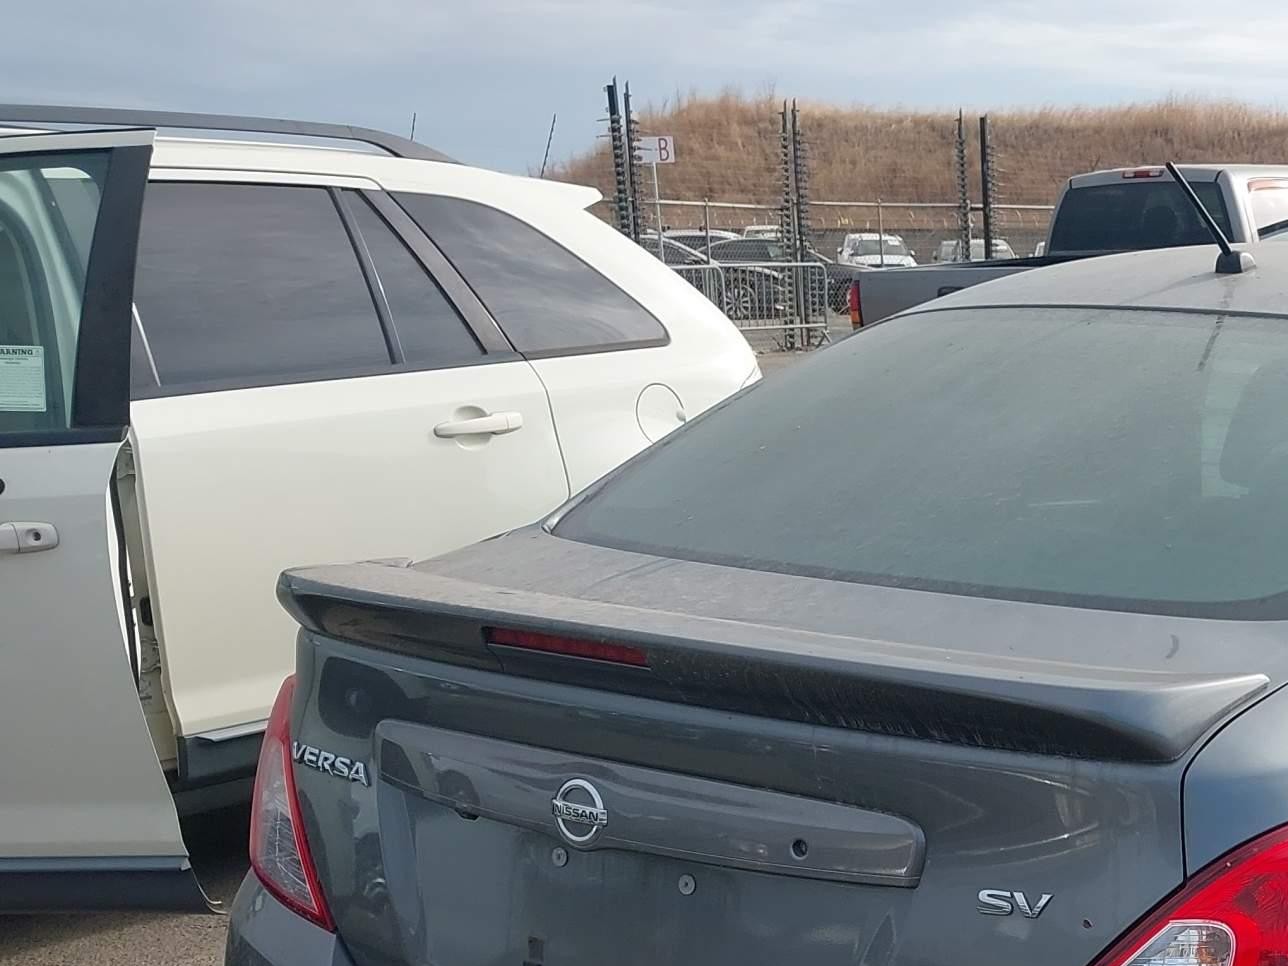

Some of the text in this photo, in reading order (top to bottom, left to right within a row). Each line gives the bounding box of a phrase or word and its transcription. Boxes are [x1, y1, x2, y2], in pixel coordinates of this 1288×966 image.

[658, 137, 670, 162] B
[292, 741, 369, 787] VERSA
[552, 801, 599, 822] NISSAN
[977, 889, 1053, 919] SV
